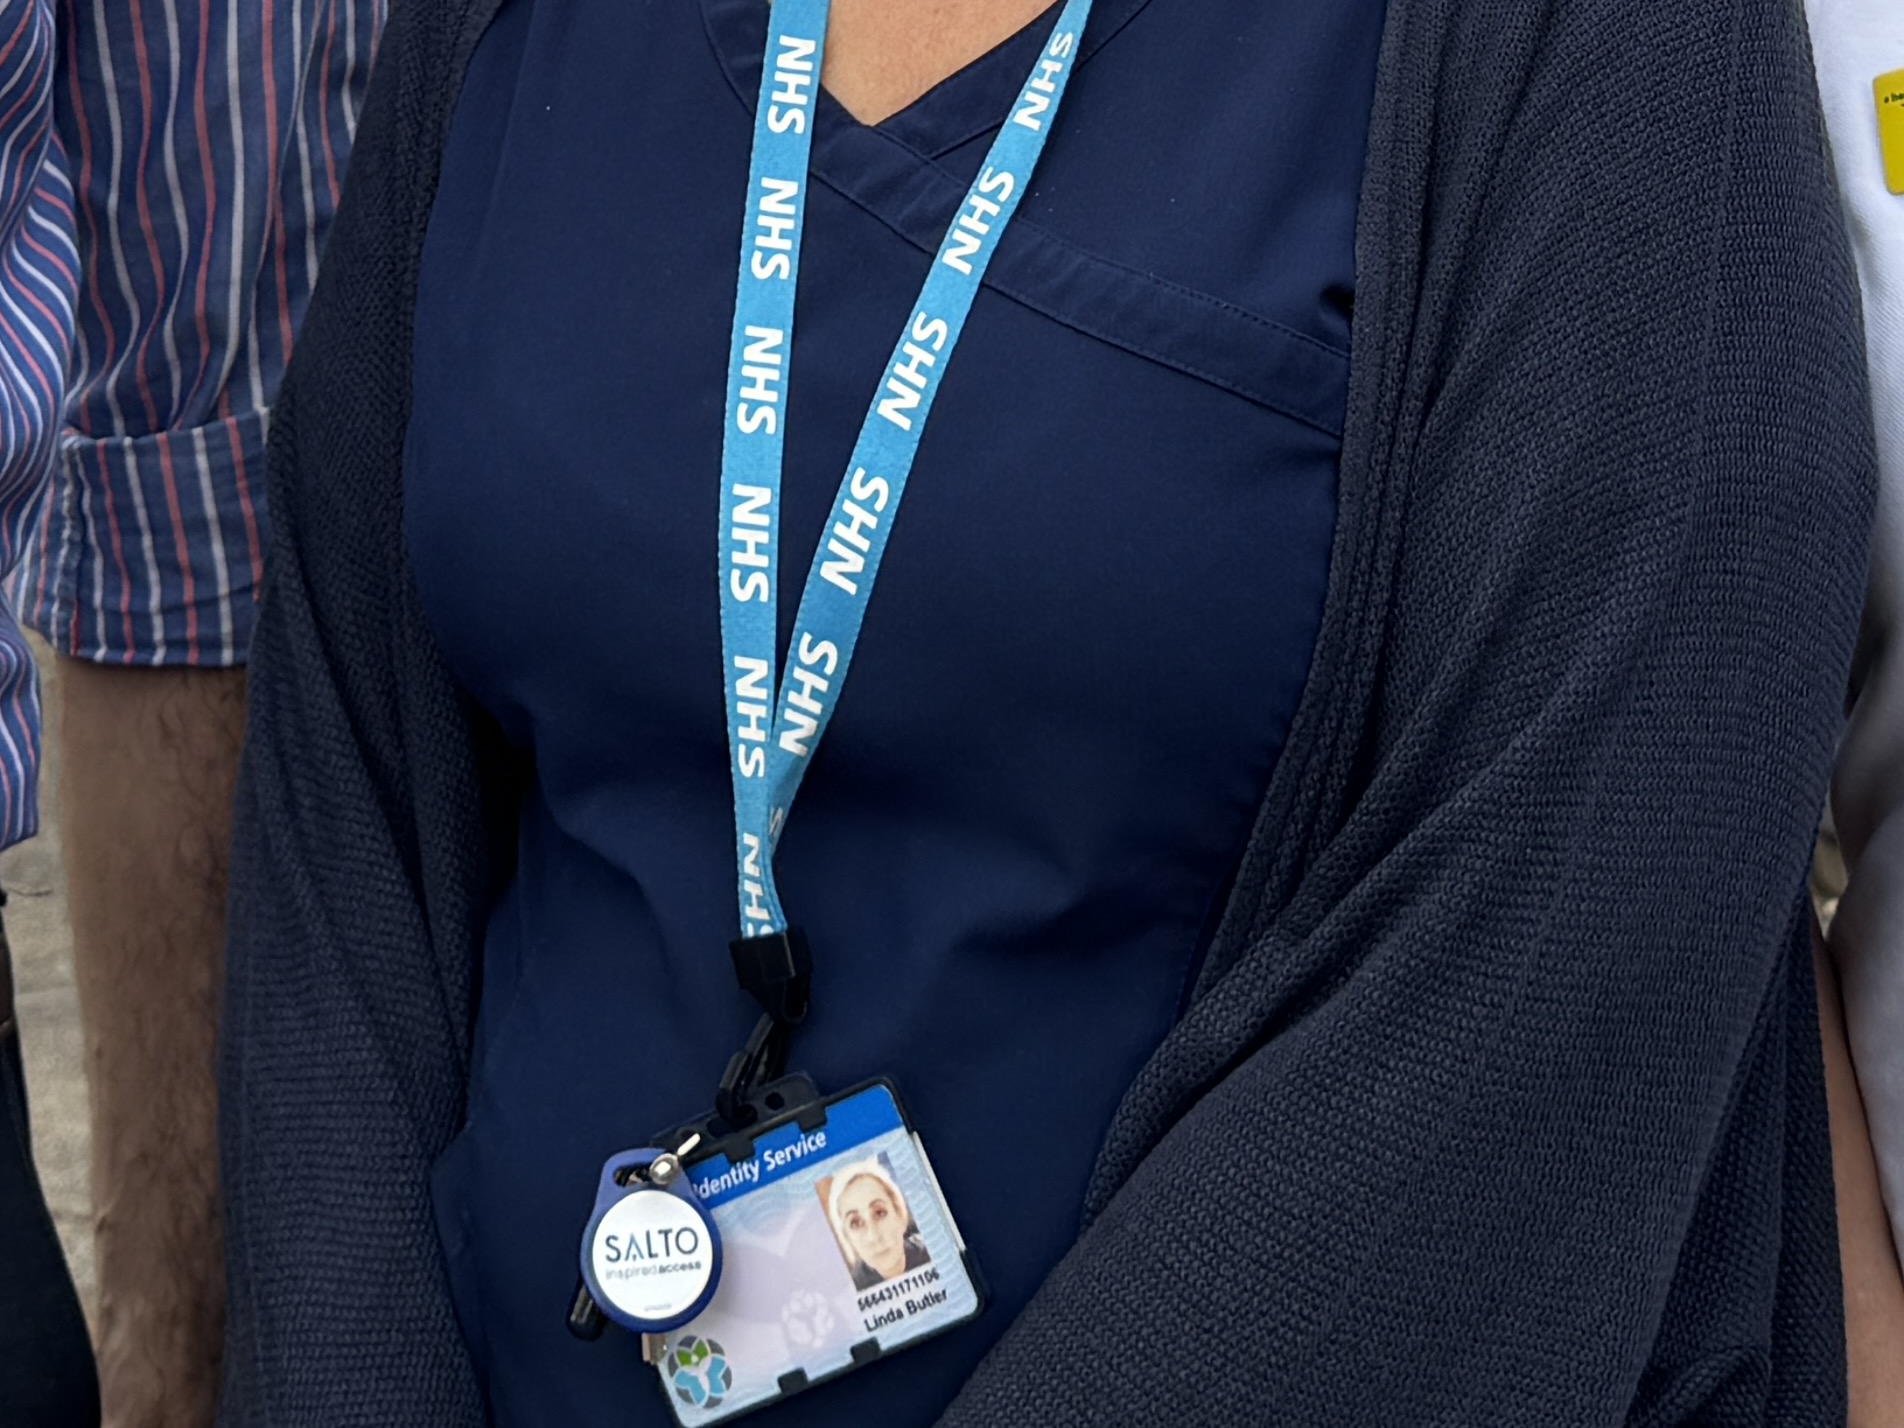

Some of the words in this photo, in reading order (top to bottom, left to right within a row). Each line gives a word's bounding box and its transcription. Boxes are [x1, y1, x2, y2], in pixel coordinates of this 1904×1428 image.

[768, 36, 815, 133] NHS
[752, 178, 798, 279] NHS
[737, 326, 783, 434] NHS
[780, 633, 837, 753] NHS
[820, 468, 888, 594] NHS
[878, 312, 947, 430] NHS
[943, 167, 1014, 275] NHS
[1014, 33, 1073, 130] NHS
[731, 484, 771, 602] NHS
[735, 656, 768, 777] NHS
[764, 1131, 827, 1172] Service
[605, 1226, 699, 1263] SALTO
[864, 1307, 904, 1333] Linda
[905, 1288, 947, 1315] Butler
